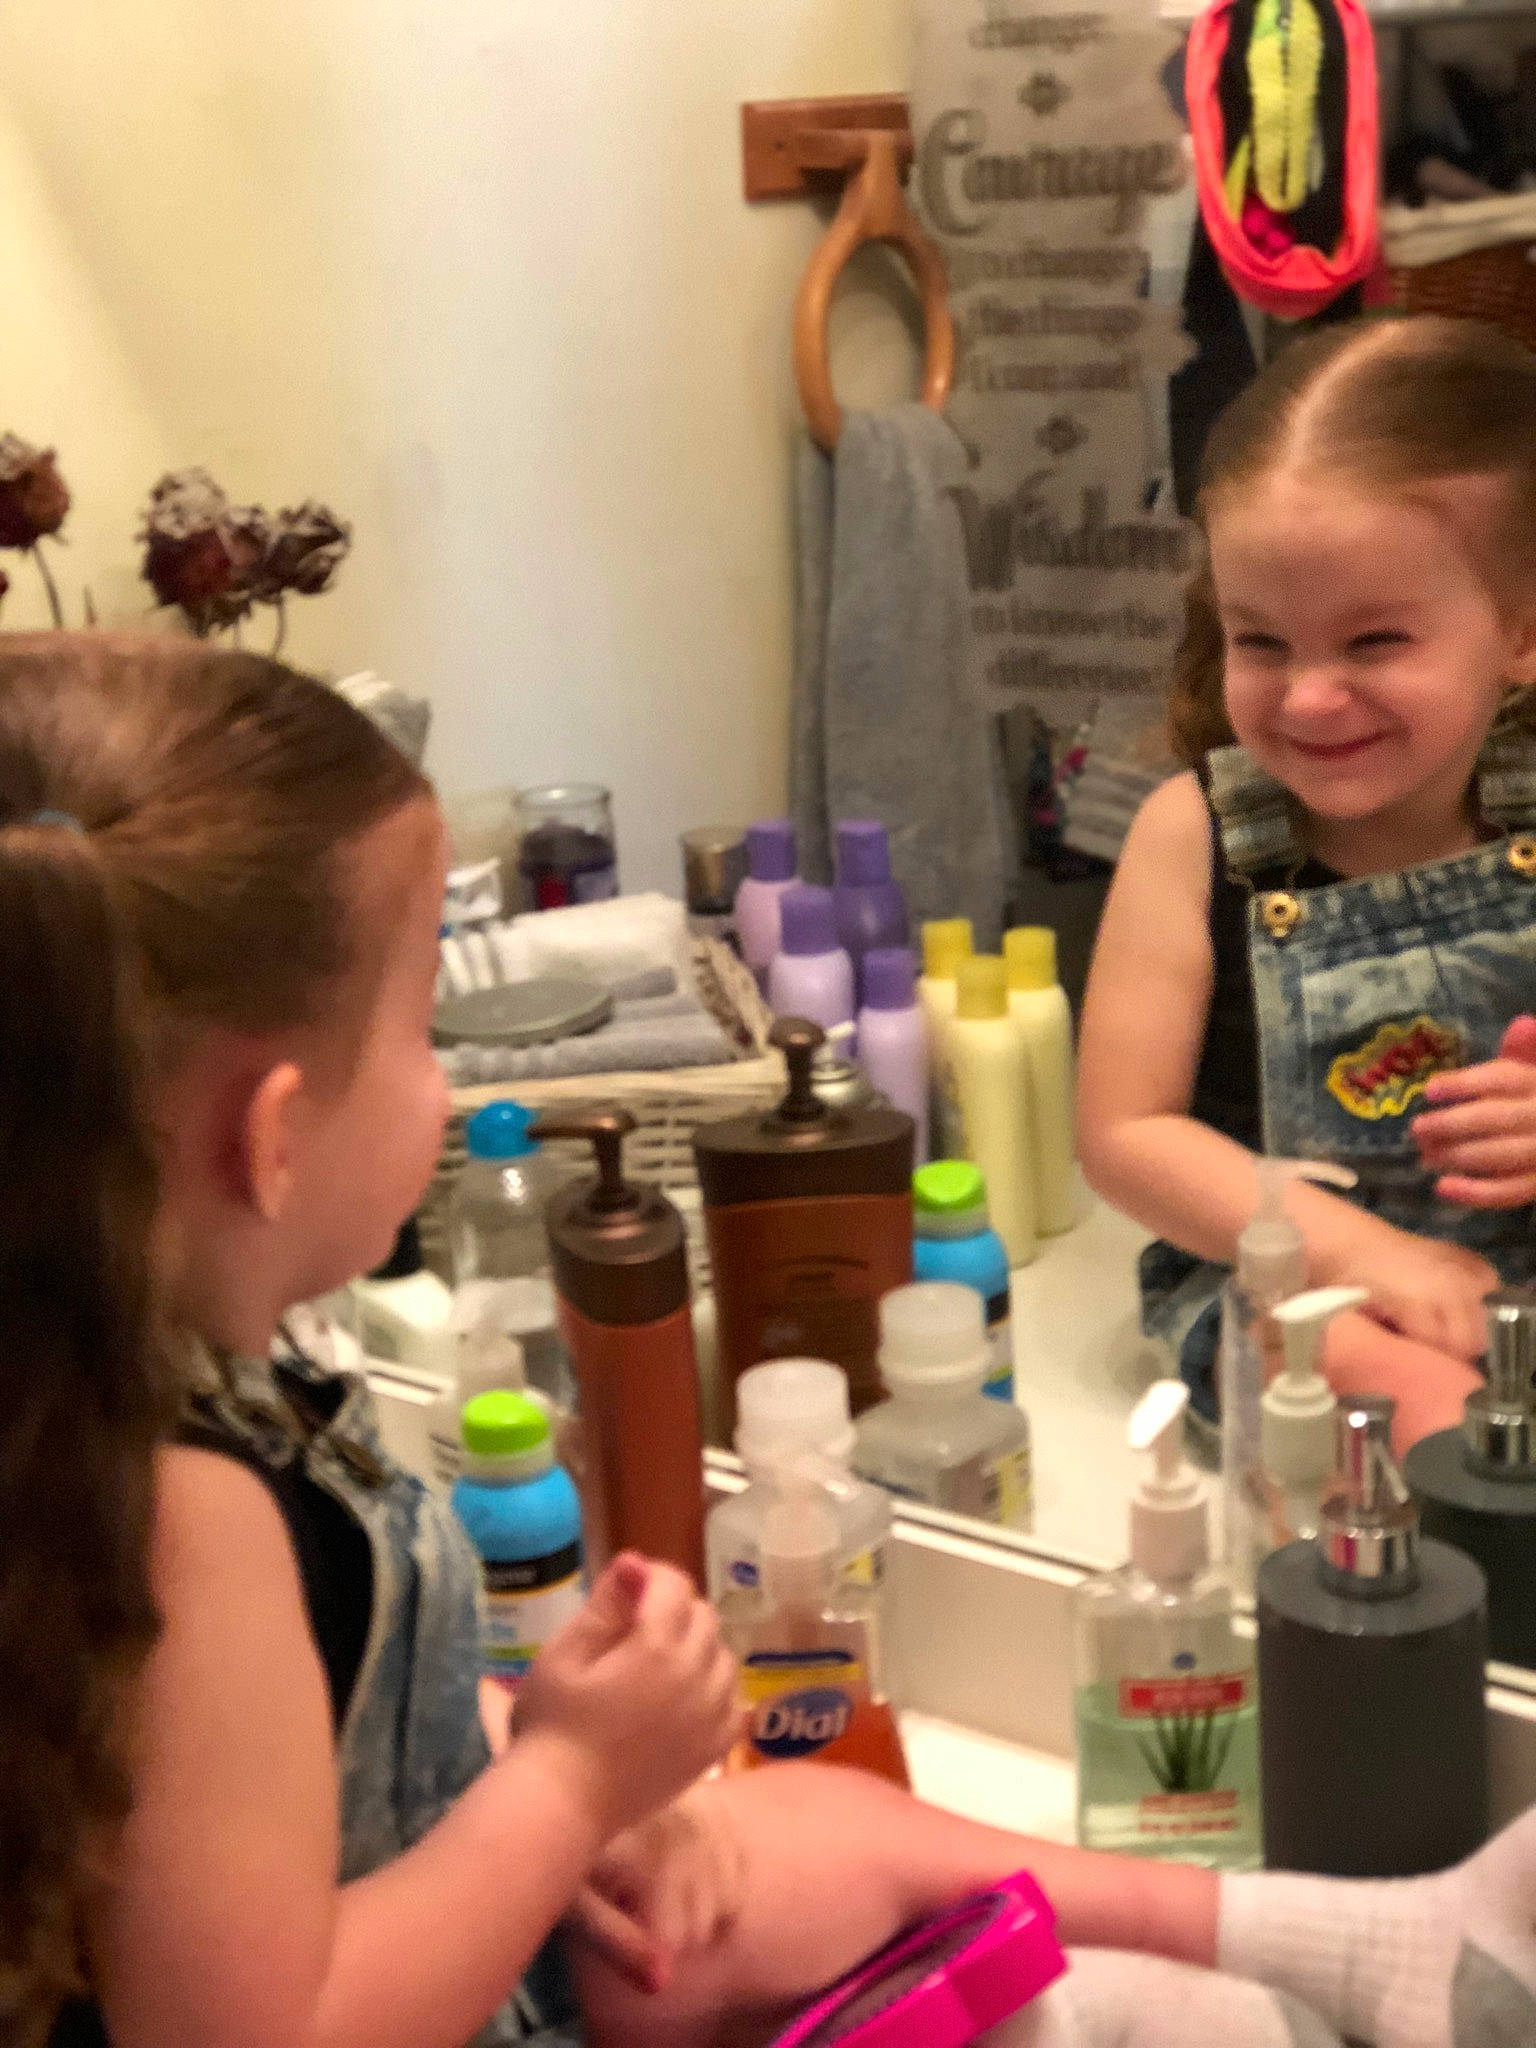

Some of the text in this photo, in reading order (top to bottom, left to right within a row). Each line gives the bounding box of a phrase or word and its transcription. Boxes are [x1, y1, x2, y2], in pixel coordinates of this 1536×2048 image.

[918, 108, 1187, 237] Courage
[942, 468, 1190, 592] Wisdom
[756, 1703, 849, 1741] Dial
